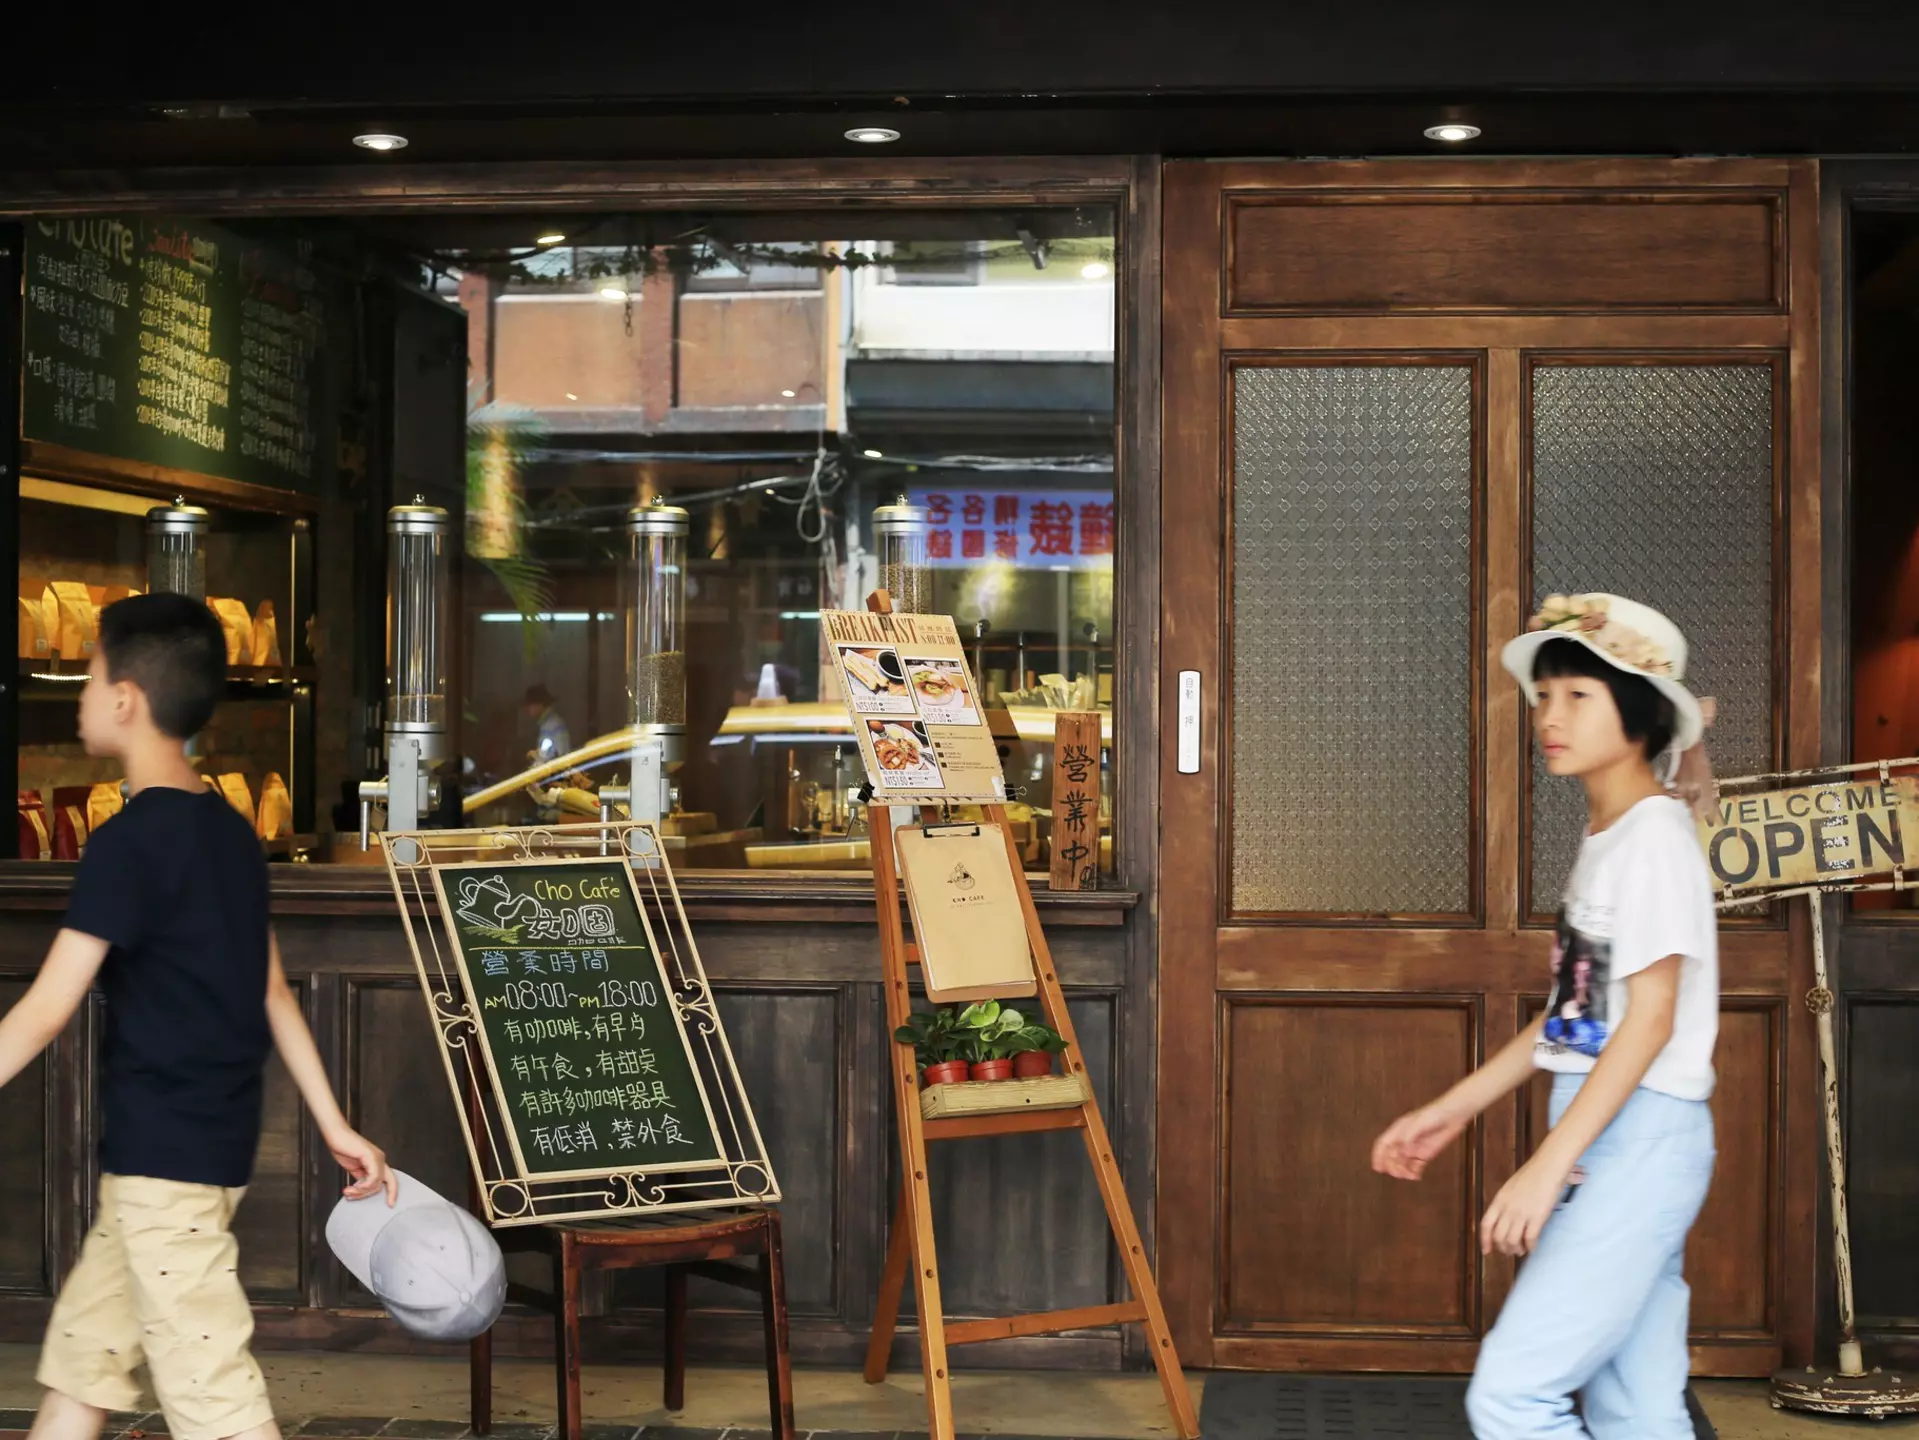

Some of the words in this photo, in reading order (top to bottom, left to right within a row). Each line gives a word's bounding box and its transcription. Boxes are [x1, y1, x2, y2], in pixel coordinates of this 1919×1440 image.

[826, 613, 918, 644] BREAKFAST
[1059, 743, 1095, 883] 營業中
[1708, 809, 1906, 885] OPEN
[534, 878, 573, 902] Cho
